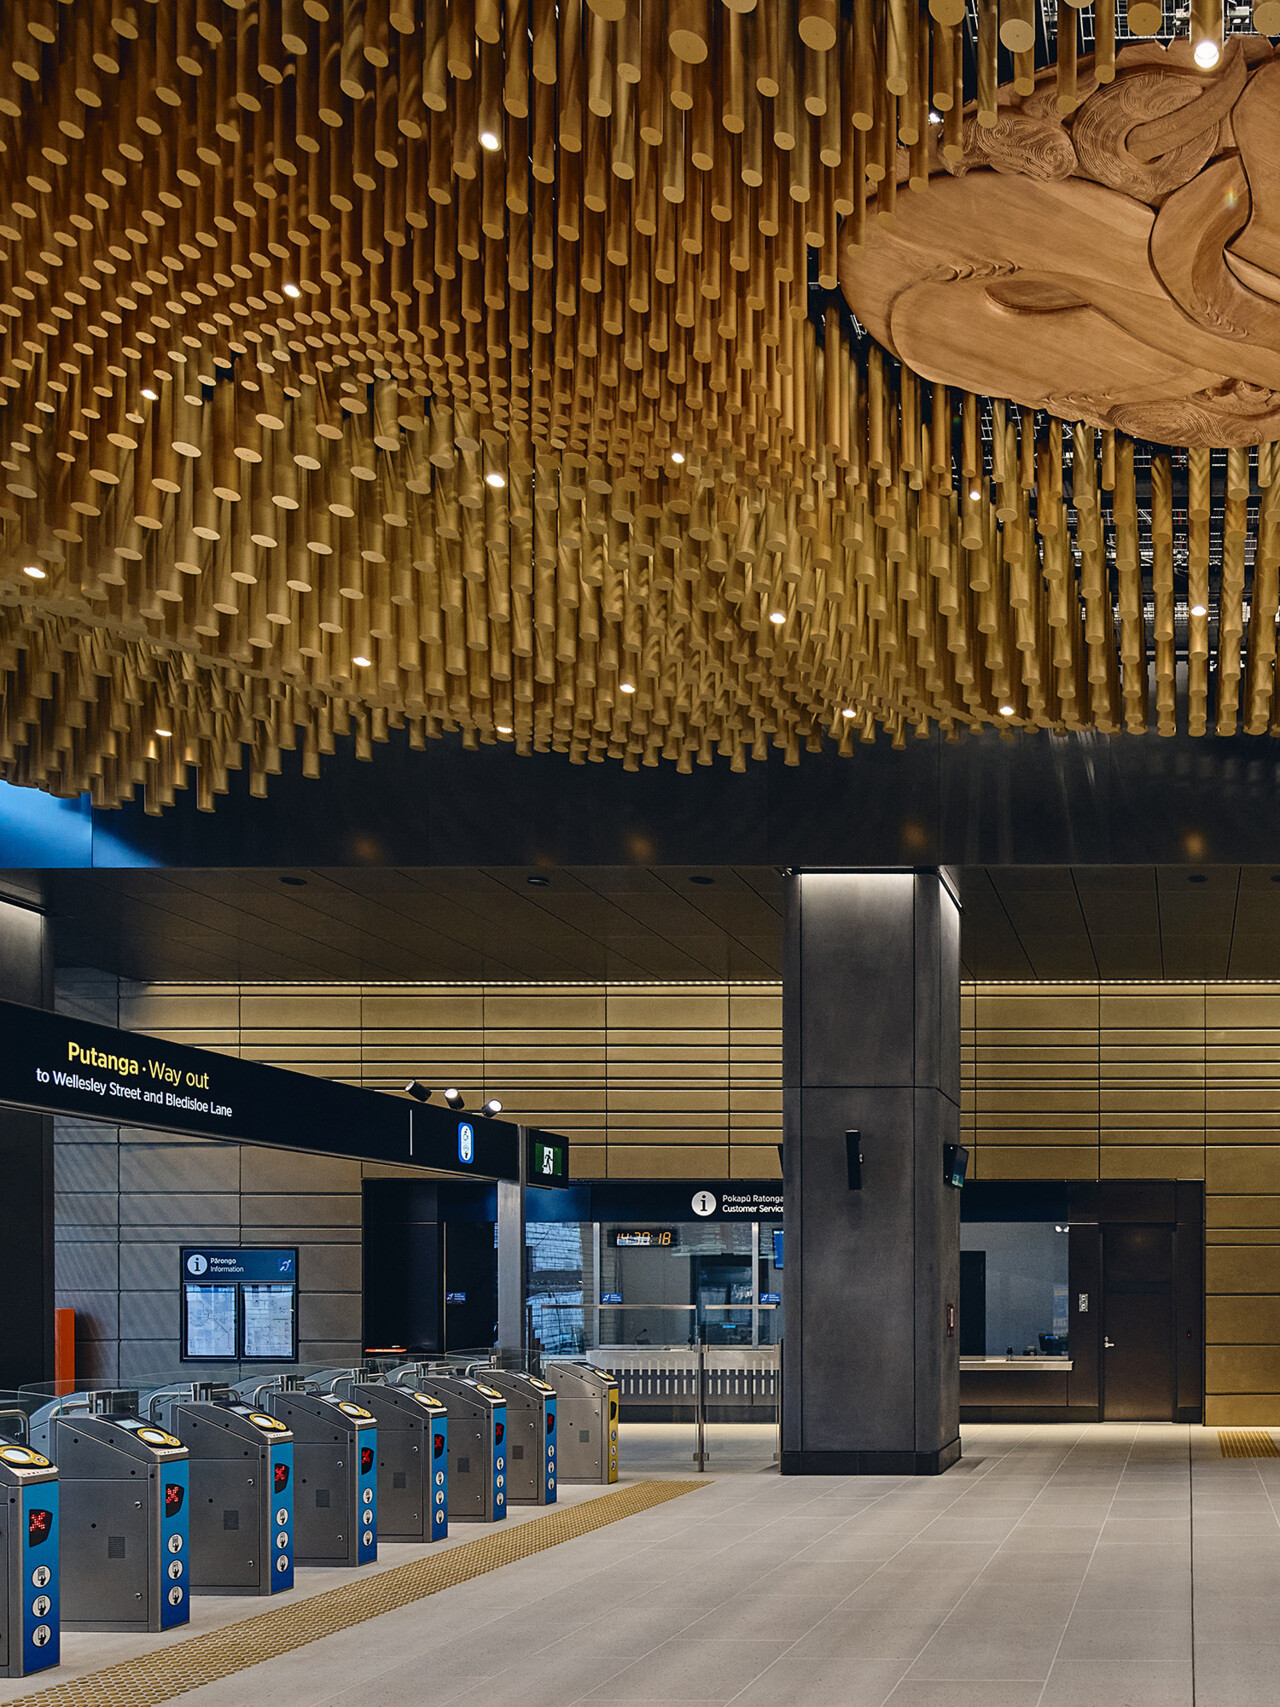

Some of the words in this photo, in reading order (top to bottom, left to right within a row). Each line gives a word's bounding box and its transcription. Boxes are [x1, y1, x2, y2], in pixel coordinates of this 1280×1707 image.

[68, 1041, 138, 1076] Putanga
[148, 1059, 182, 1087] Way
[185, 1072, 210, 1090] out
[36, 1067, 50, 1083] to
[52, 1070, 107, 1096] Wellesley
[109, 1081, 142, 1101] Street
[143, 1091, 164, 1105] and
[165, 1092, 209, 1113] Bledisloe
[210, 1101, 233, 1117] Lane
[722, 1204, 758, 1213] Customer
[210, 1265, 245, 1273] Information
